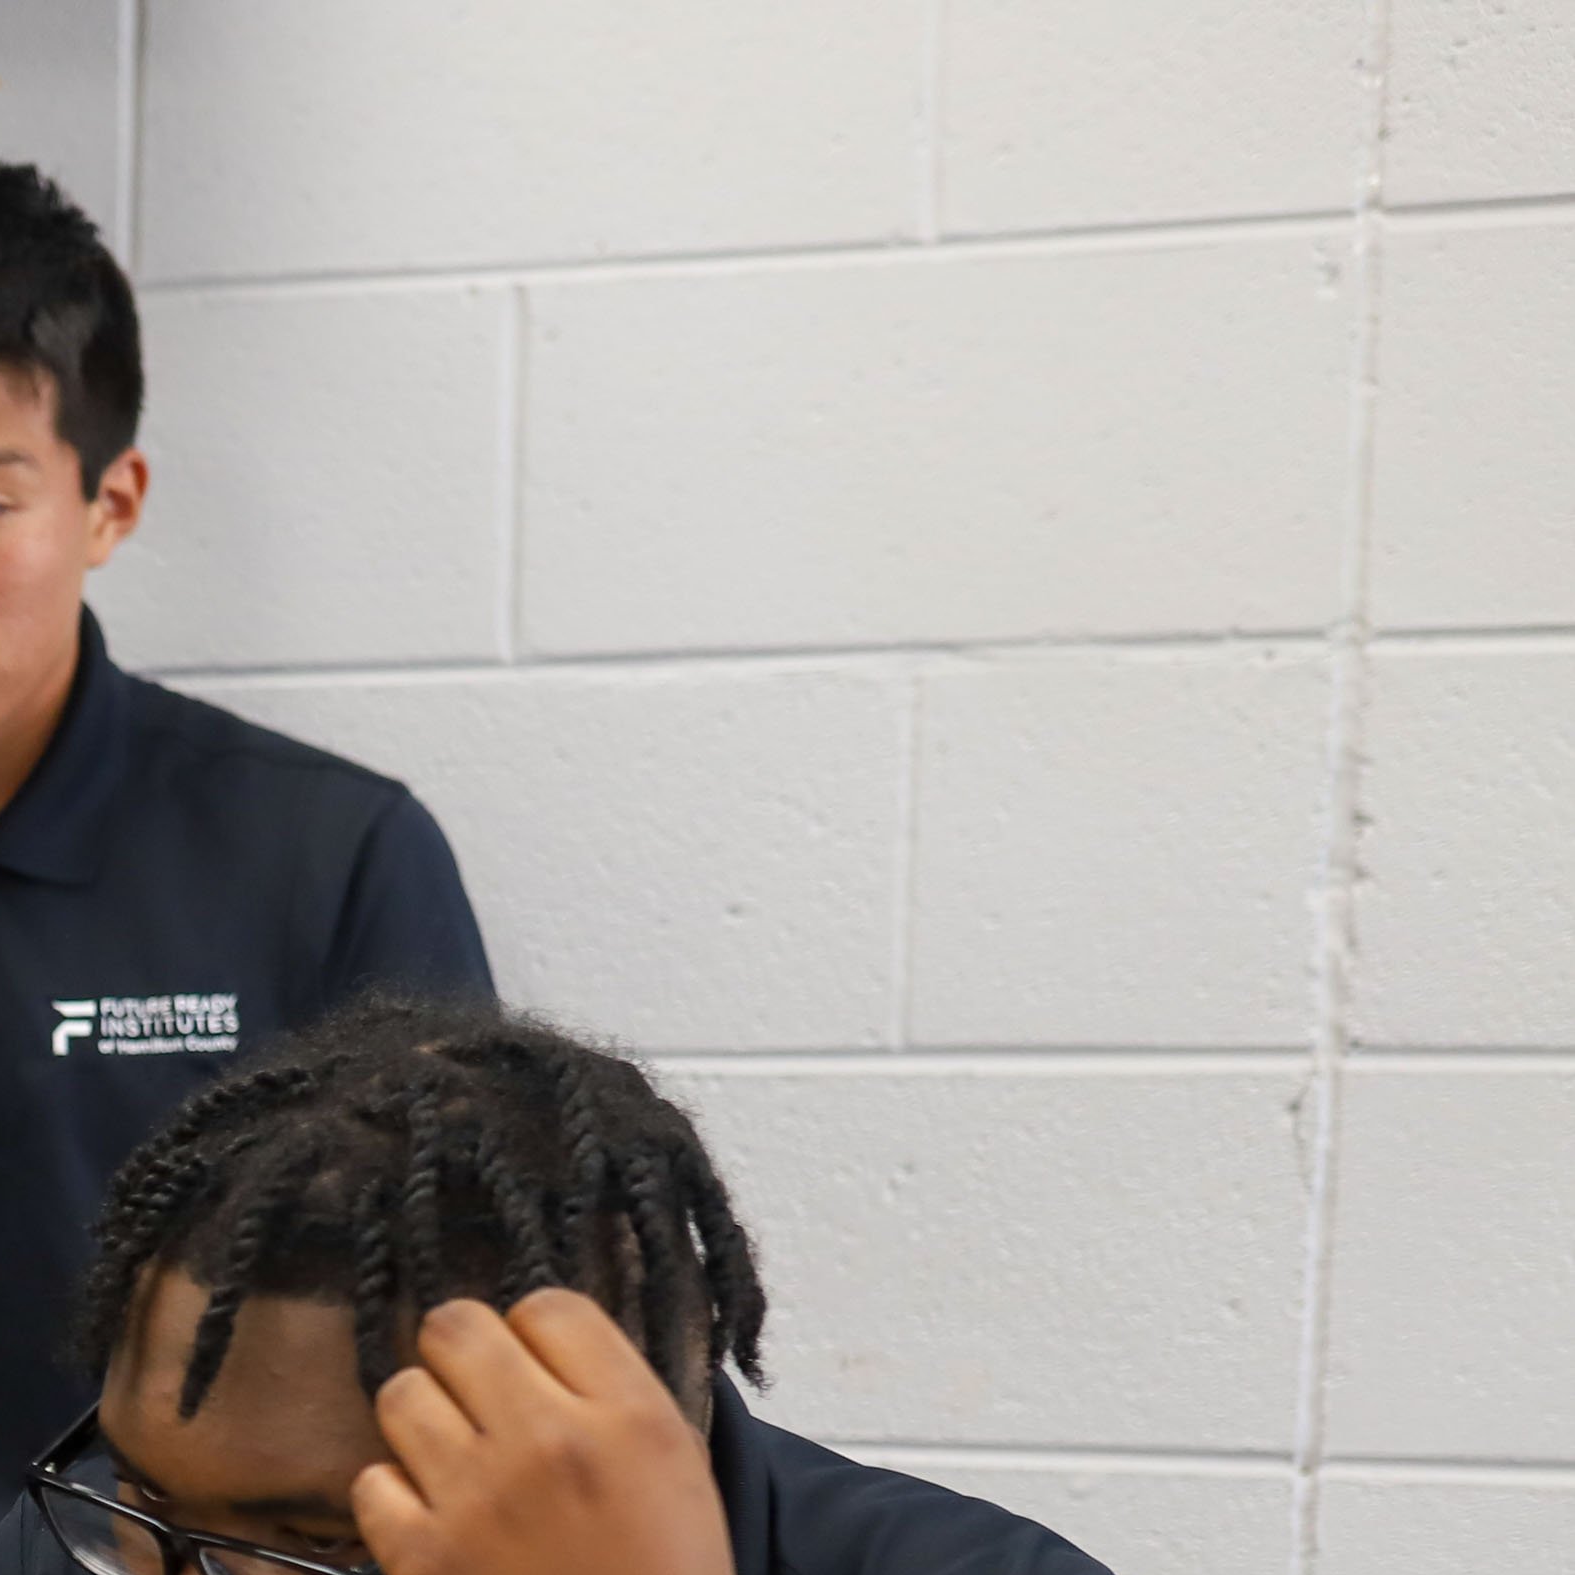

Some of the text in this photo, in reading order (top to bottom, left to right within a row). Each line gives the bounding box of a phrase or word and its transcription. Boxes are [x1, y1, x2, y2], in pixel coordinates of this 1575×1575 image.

[100, 994, 238, 1018] FUTURE READY
[100, 1012, 239, 1037] INSTITUTES
